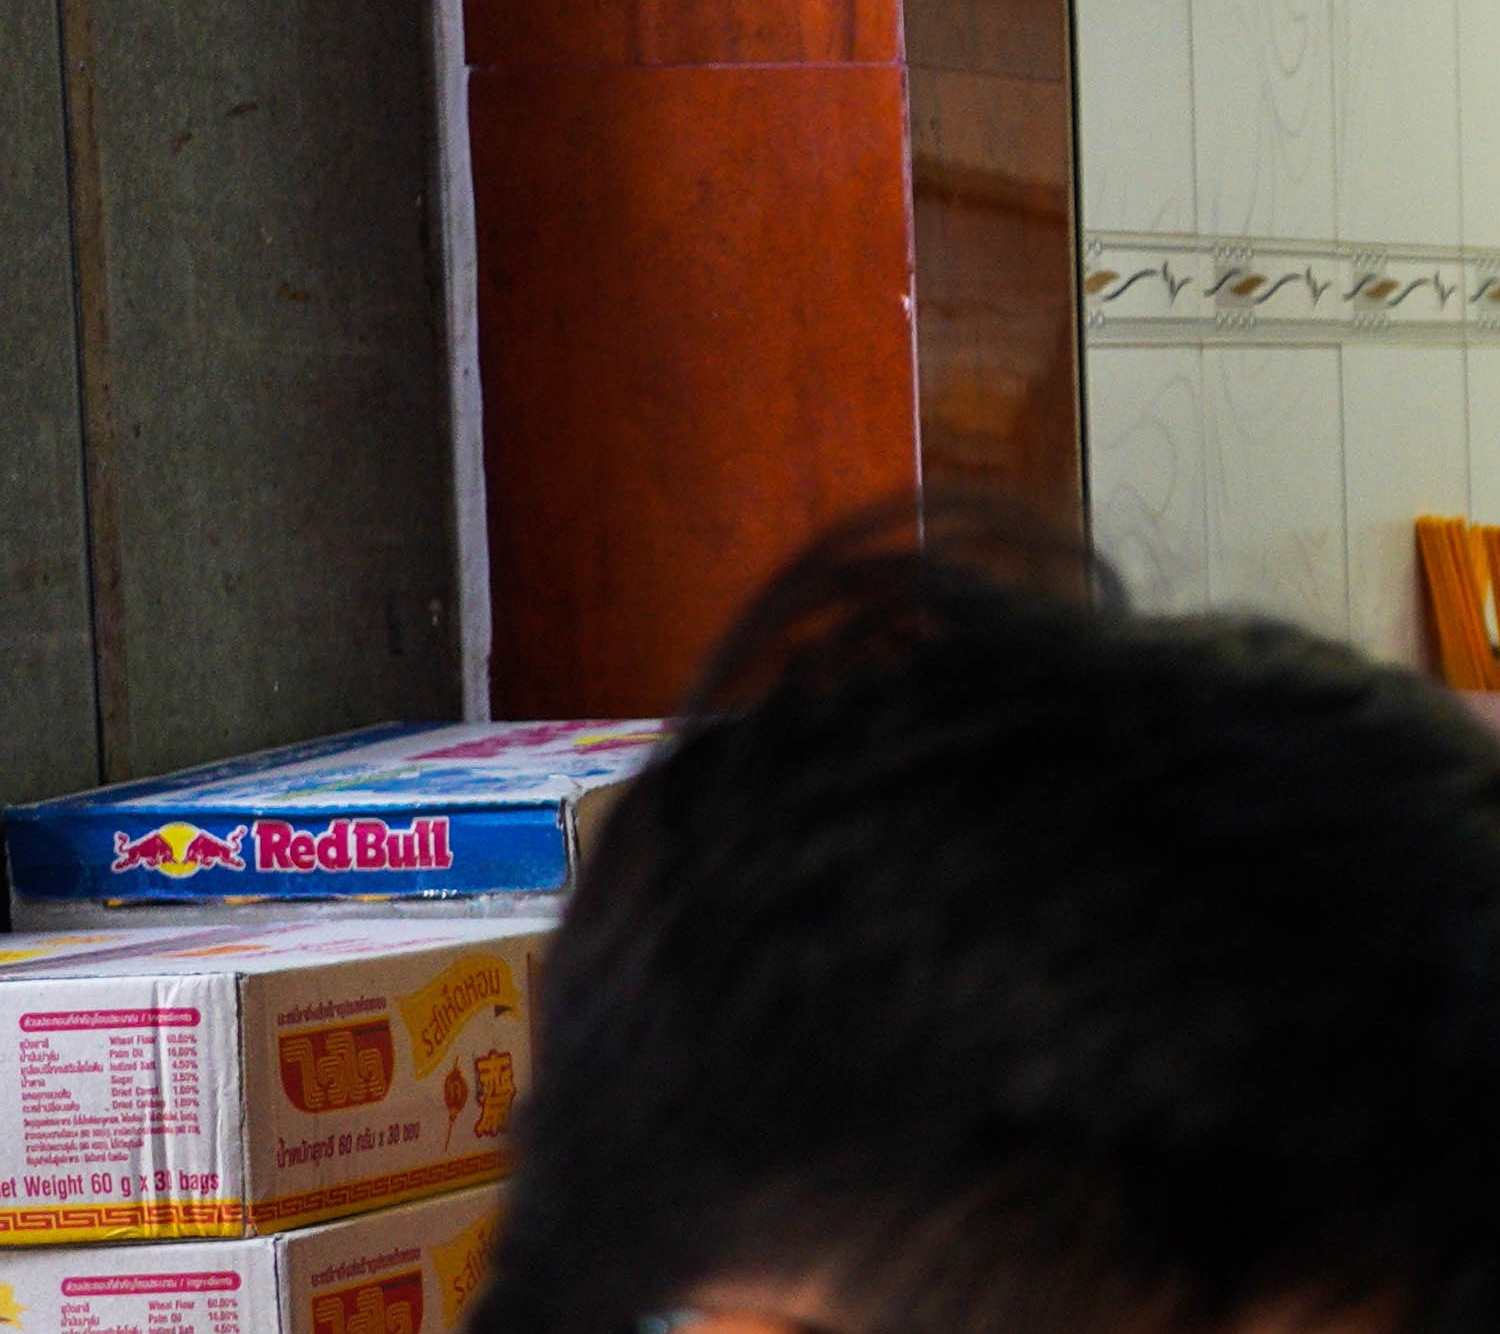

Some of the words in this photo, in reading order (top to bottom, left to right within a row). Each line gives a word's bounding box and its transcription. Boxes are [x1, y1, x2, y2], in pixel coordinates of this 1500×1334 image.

[254, 819, 353, 871] Red
[362, 817, 453, 871] Bull
[0, 1179, 17, 1198] et
[24, 1173, 83, 1200] Weight
[91, 1172, 113, 1194] 60
[121, 1175, 131, 1197] g
[139, 1175, 149, 1193] x
[179, 1169, 219, 1196] bags
